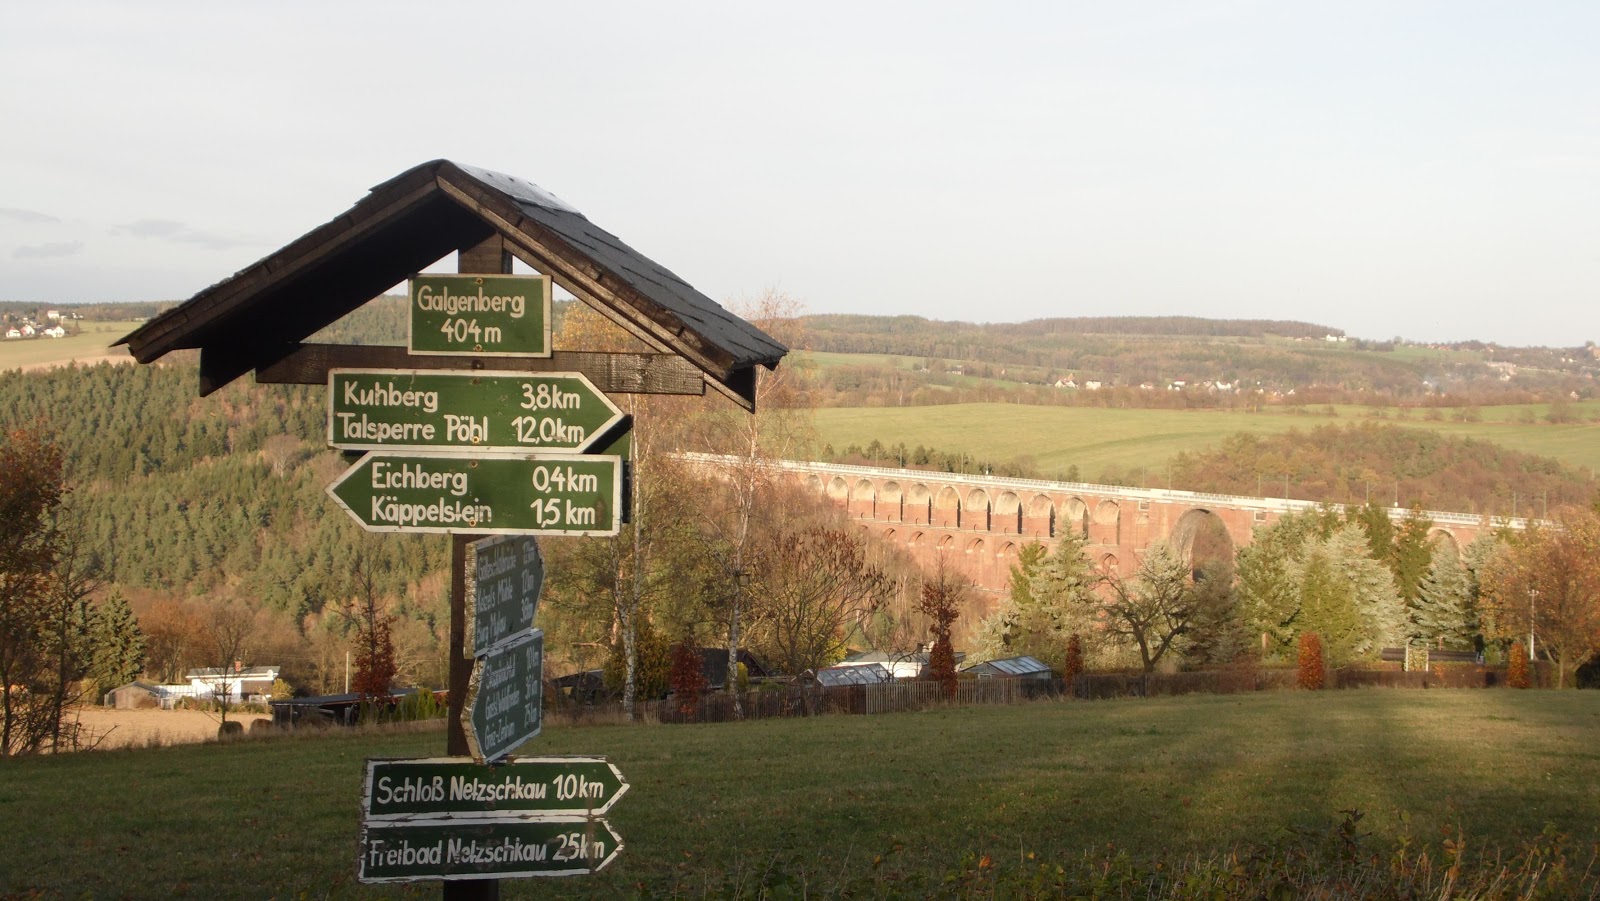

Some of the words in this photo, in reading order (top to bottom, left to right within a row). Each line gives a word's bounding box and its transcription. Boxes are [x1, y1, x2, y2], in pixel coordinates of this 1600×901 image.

[417, 285, 525, 318] Galgenberg
[344, 381, 438, 412] Kuhberg
[337, 412, 436, 442] Talsperre
[443, 414, 488, 442] Pöhl
[371, 462, 468, 496] Eichberg
[371, 496, 492, 526] Käppelstein
[376, 775, 445, 805] Schloß
[449, 775, 546, 802] Netzschkau
[369, 839, 442, 867] Freibad
[447, 837, 547, 865] Netzschkau
